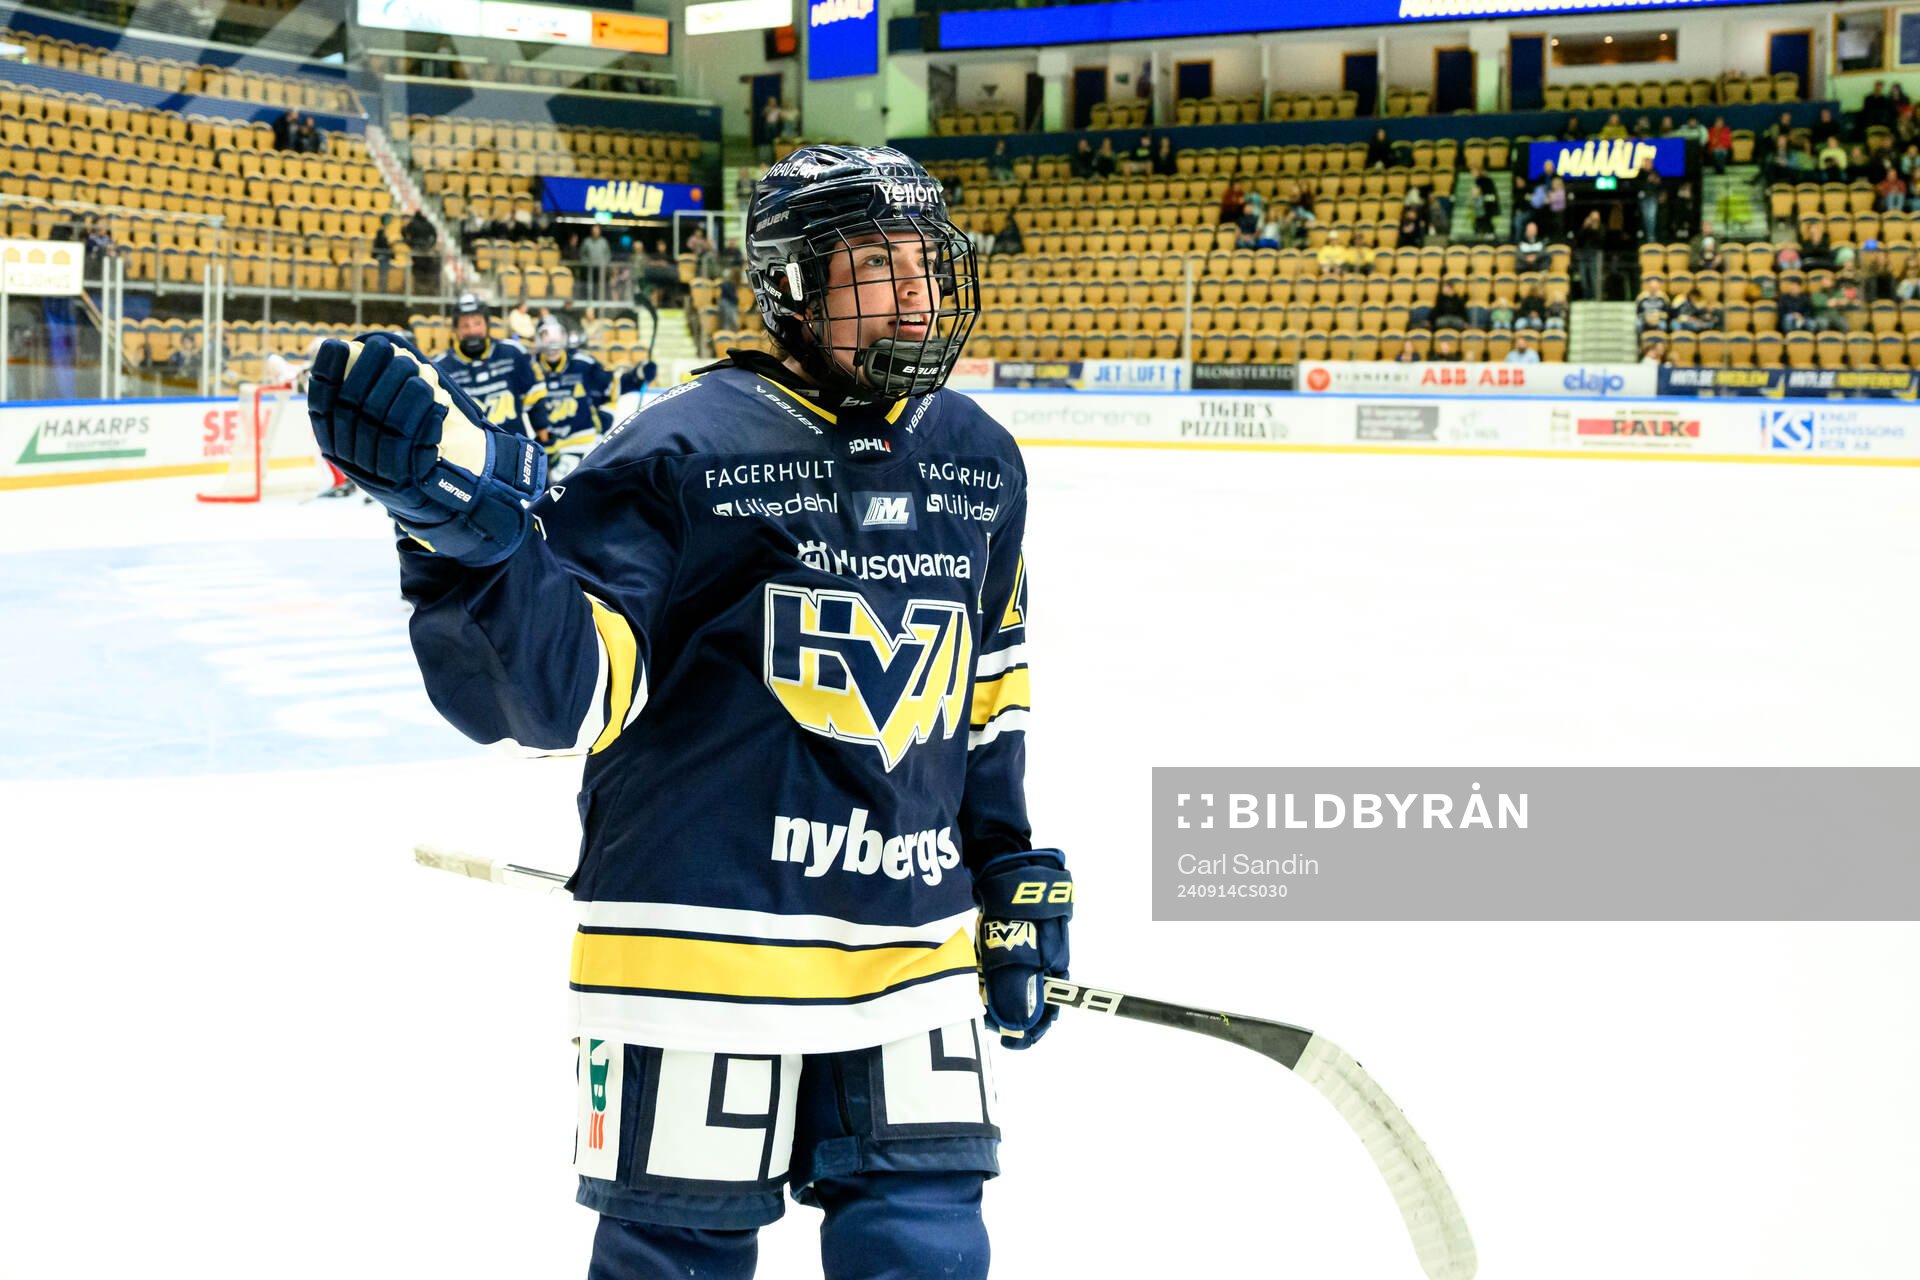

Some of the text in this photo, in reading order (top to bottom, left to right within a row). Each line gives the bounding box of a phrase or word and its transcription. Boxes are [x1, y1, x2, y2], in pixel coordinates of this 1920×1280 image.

[877, 181, 940, 205] Yellon
[1421, 368, 1525, 387] ABB ABB
[1563, 368, 1625, 396] elajo
[764, 393, 824, 435] BAUER
[1012, 406, 1151, 428] perforera
[1198, 401, 1274, 419] TIGER'S
[43, 416, 150, 438] HAKARPS
[1180, 420, 1266, 439] PIZZERIA
[1773, 410, 1815, 450] KS
[705, 460, 835, 489] FAGERHULT
[735, 493, 839, 517] Liljedahl
[770, 807, 961, 887] nybergs
